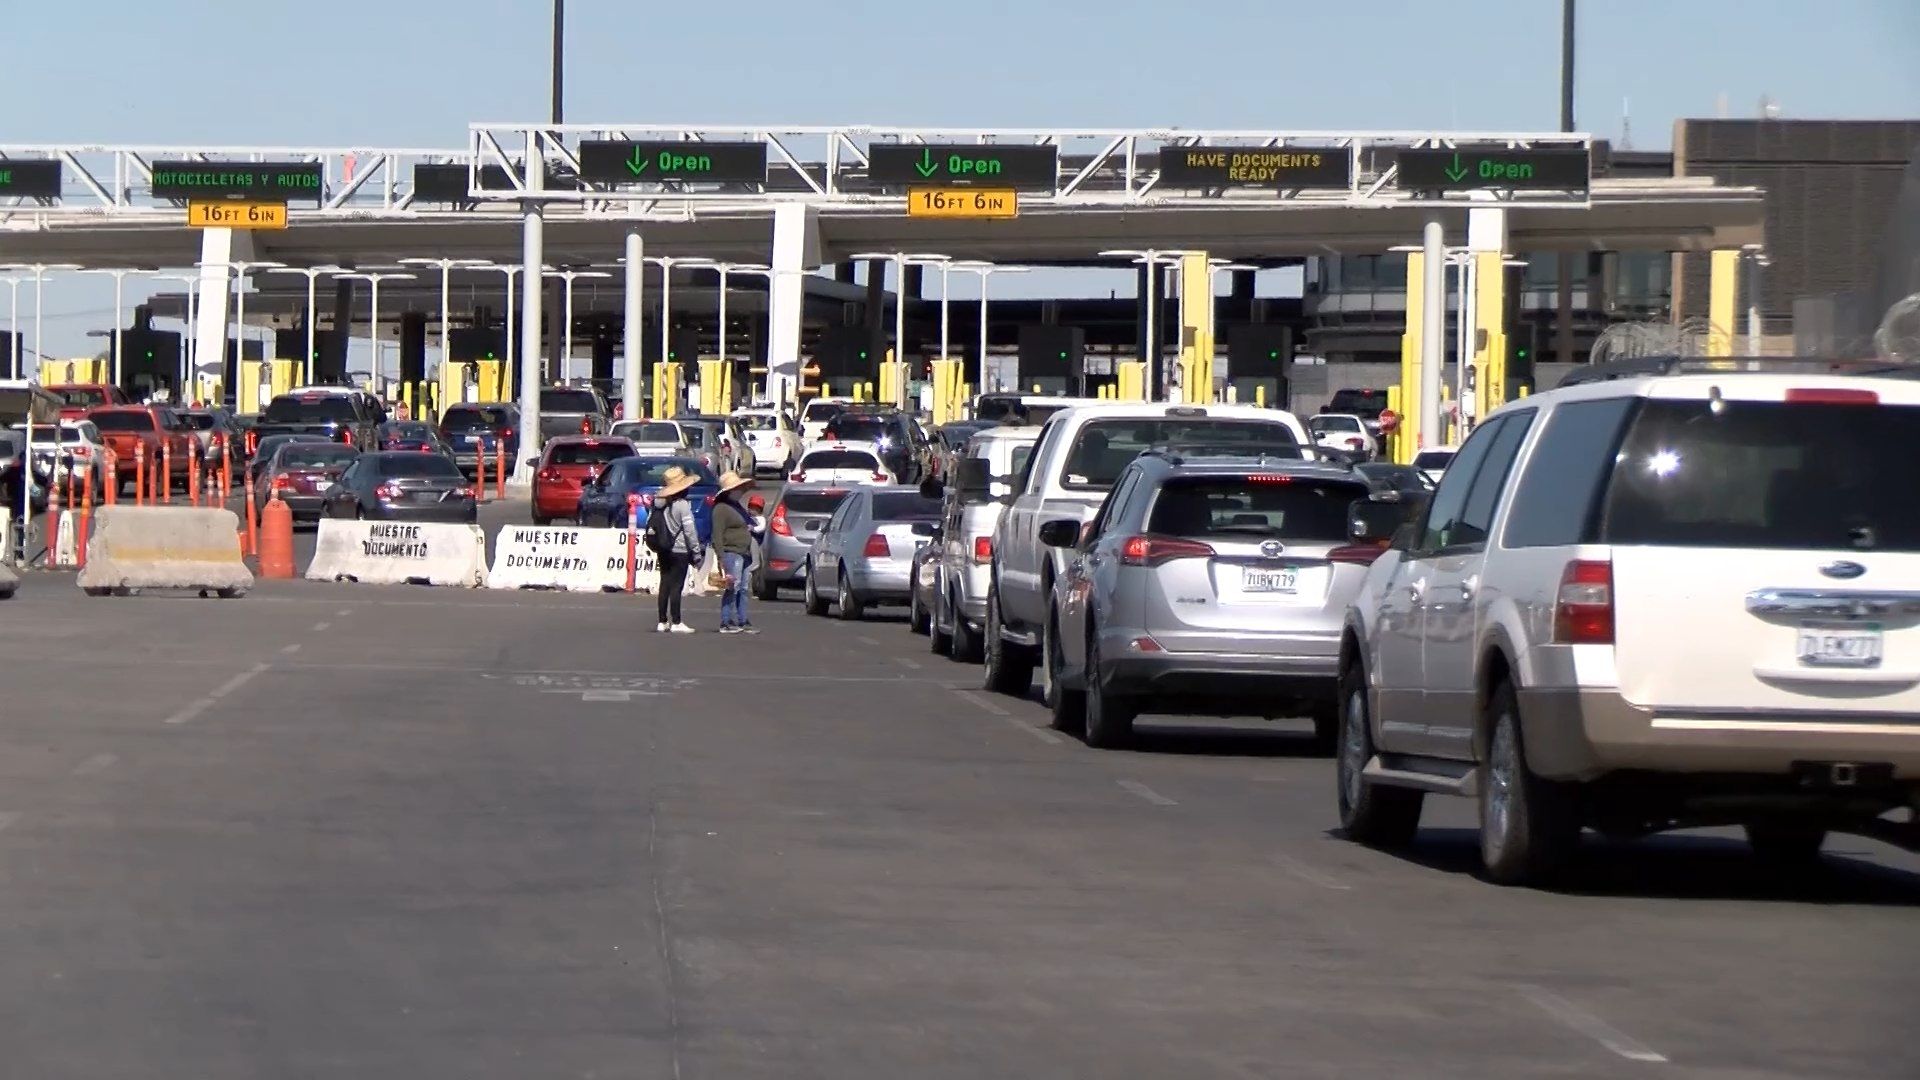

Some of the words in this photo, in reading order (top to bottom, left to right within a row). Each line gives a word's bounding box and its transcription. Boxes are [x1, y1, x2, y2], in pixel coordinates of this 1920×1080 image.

[659, 151, 711, 171] Open
[948, 155, 1001, 174] Open
[1187, 154, 1226, 167] HAVE
[1232, 154, 1321, 167] DOCUMENTS
[1229, 168, 1277, 181] READY
[1479, 160, 1533, 178] Open
[154, 172, 252, 185] MOTOCICLETAS
[261, 173, 268, 185] Y
[278, 174, 319, 186] AUTOS
[370, 524, 421, 539] MUESTRE
[514, 530, 578, 545] MUESTRE
[362, 540, 428, 557] DOCUMENTO
[506, 554, 588, 570] DOCUMENTO
